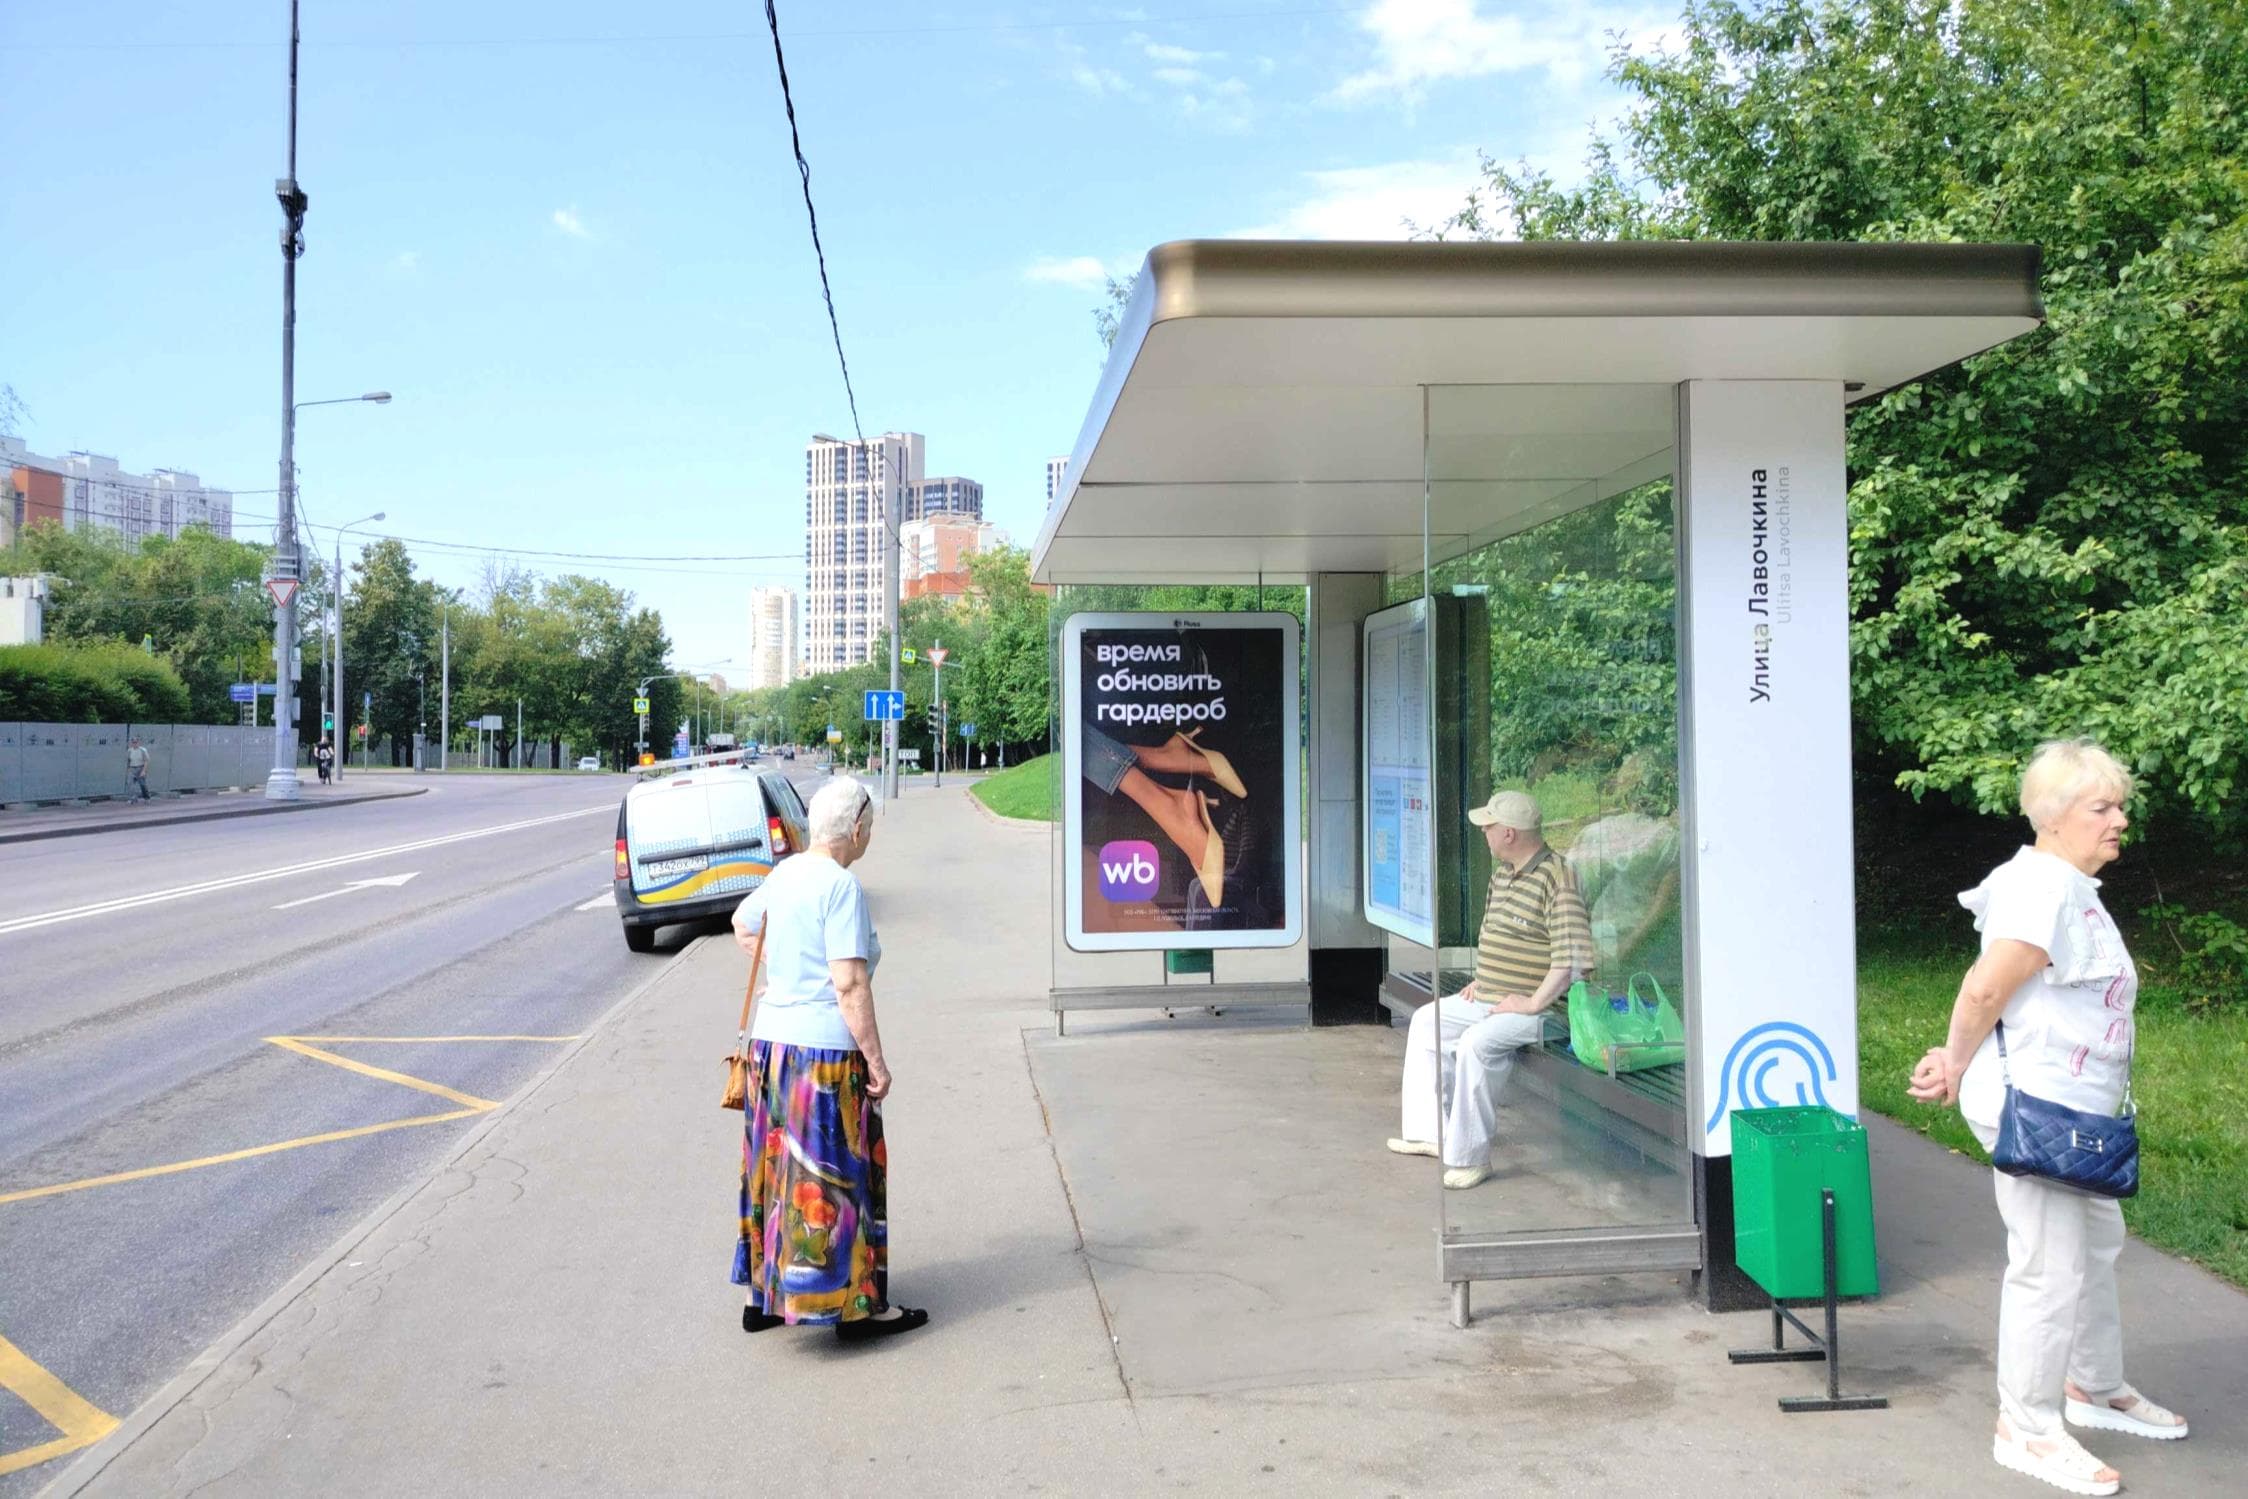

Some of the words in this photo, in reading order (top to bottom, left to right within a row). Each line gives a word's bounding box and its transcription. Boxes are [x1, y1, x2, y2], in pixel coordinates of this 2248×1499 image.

[1776, 466, 1791, 567] Lavochkina
[1748, 469, 1769, 617] Лавочкина
[1776, 573, 1791, 624] Ulitsa
[1097, 645, 1180, 667] время
[1750, 623, 1772, 703] Улица
[1097, 668, 1222, 692] обновить
[1097, 697, 1227, 726] гардероб
[1102, 852, 1155, 885] wb
